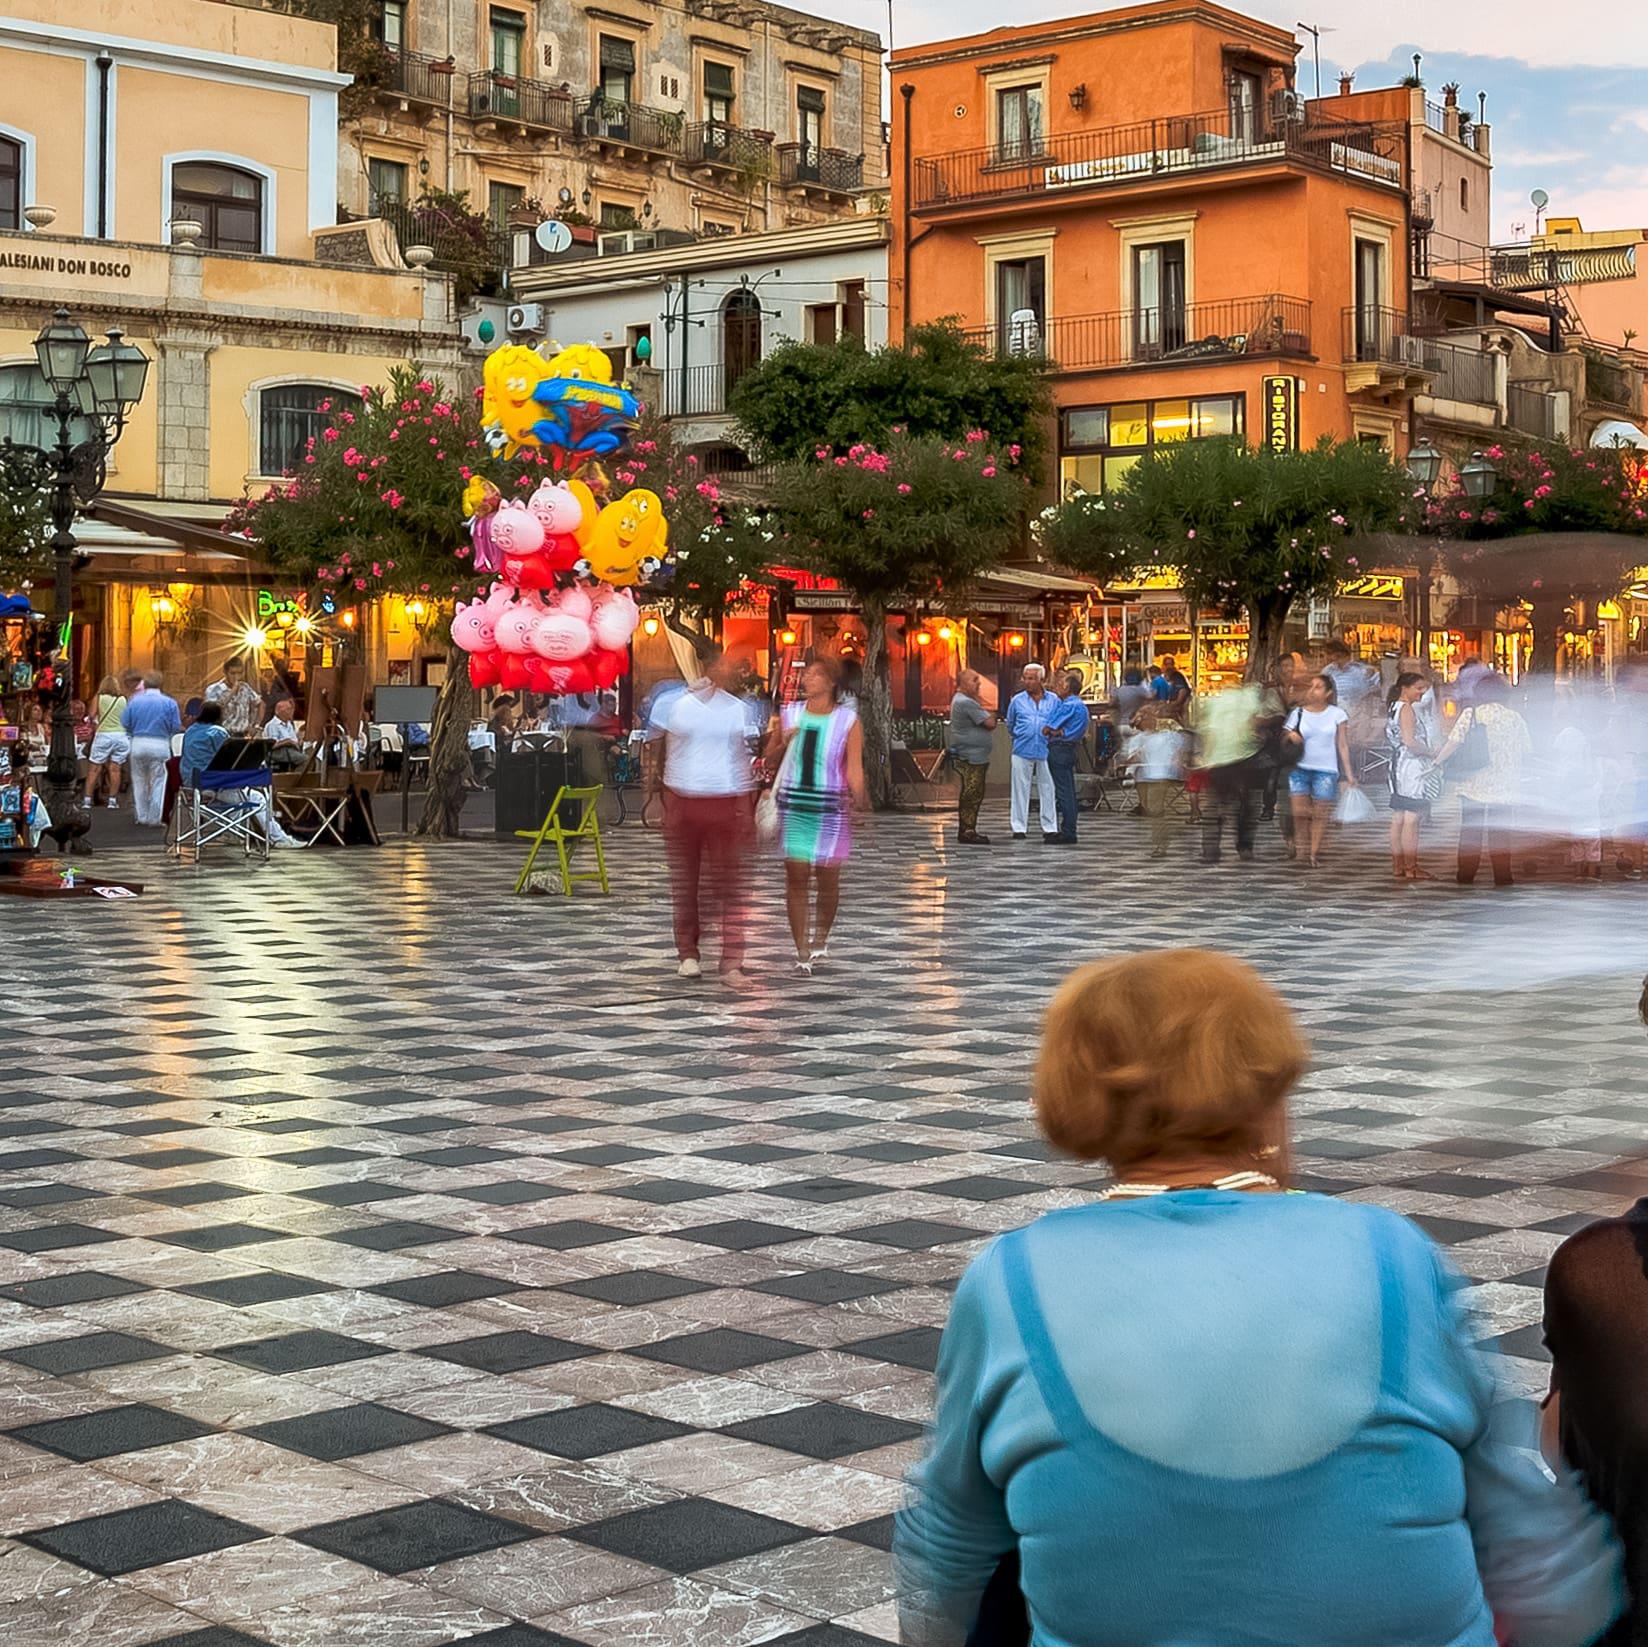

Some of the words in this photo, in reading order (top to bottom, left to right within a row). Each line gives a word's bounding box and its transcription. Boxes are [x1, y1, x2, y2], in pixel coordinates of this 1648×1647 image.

[58, 258, 86, 275] DON
[90, 261, 131, 278] BOSCO
[1271, 379, 1286, 453] RISTORANT
